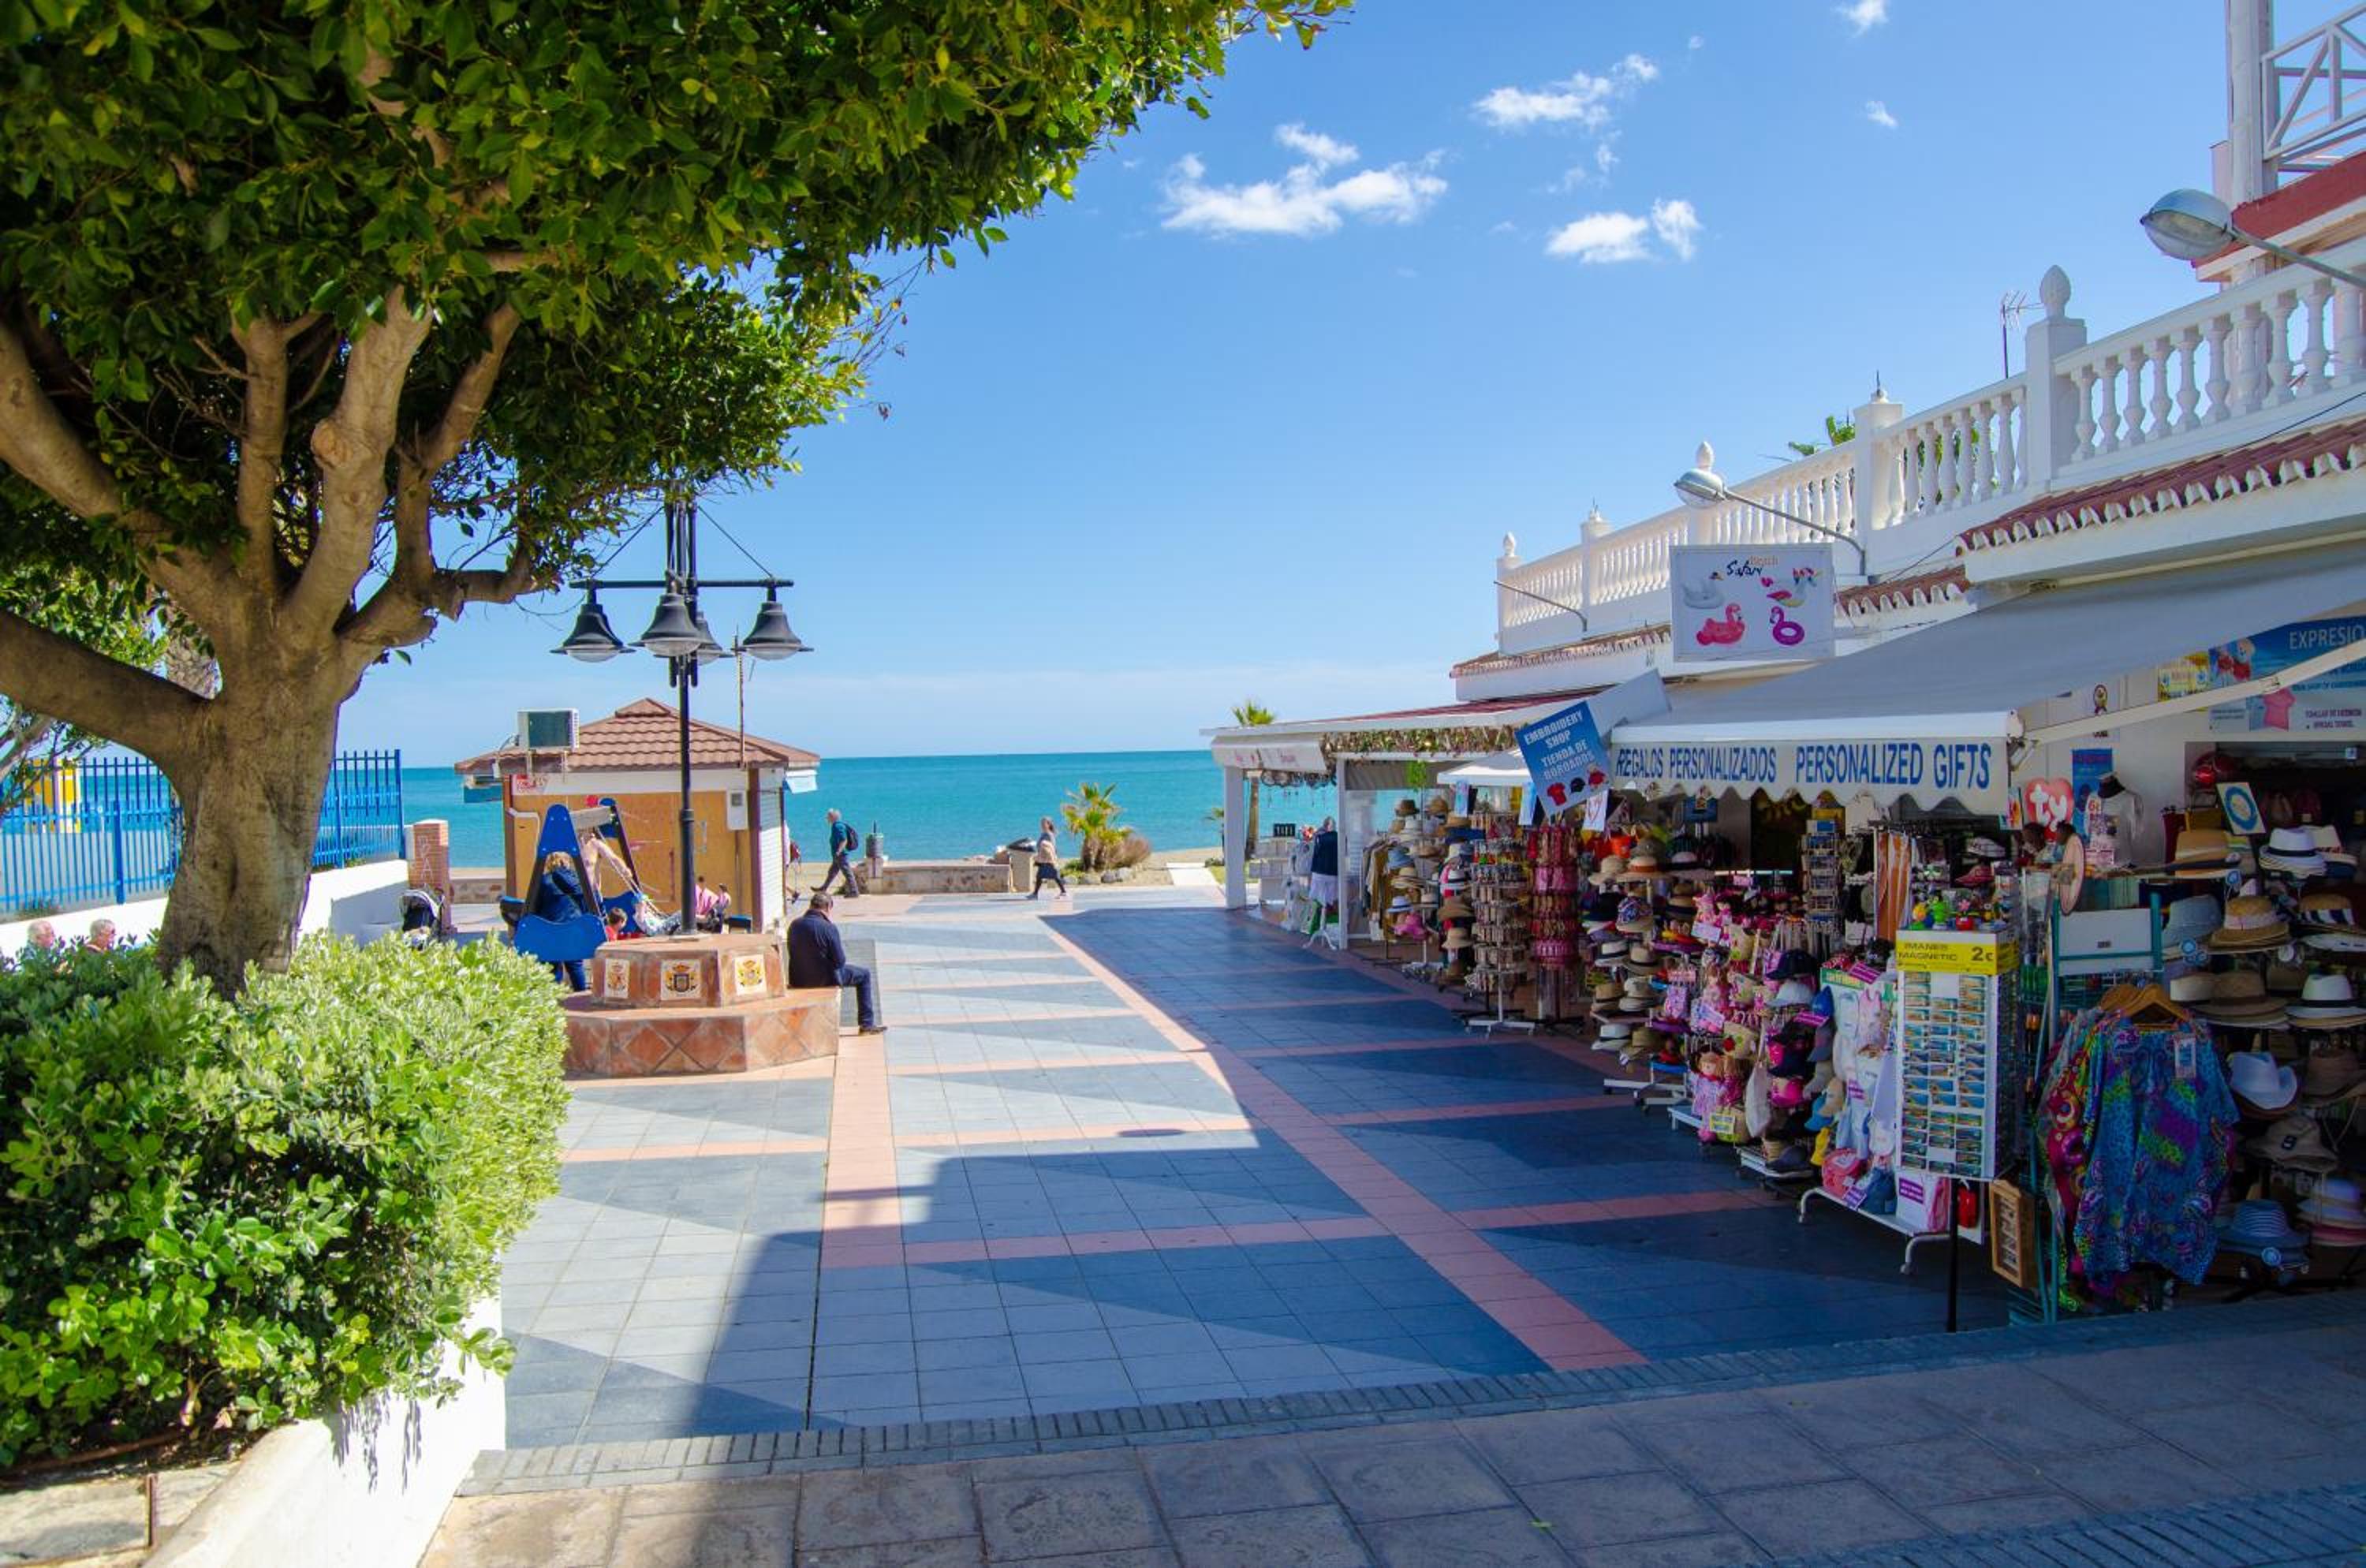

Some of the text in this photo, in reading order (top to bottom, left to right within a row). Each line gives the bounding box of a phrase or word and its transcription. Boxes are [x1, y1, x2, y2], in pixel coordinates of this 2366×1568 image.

[1524, 711, 1584, 745] EMBROIDERY
[1546, 730, 1571, 749] SHOP
[1541, 739, 1588, 767] TIENDA DE
[1616, 742, 1992, 790] REGALOS PERSONALIZADOS PERSONALIZED GIFTS
[1898, 952, 1957, 961] MAGNETIC
